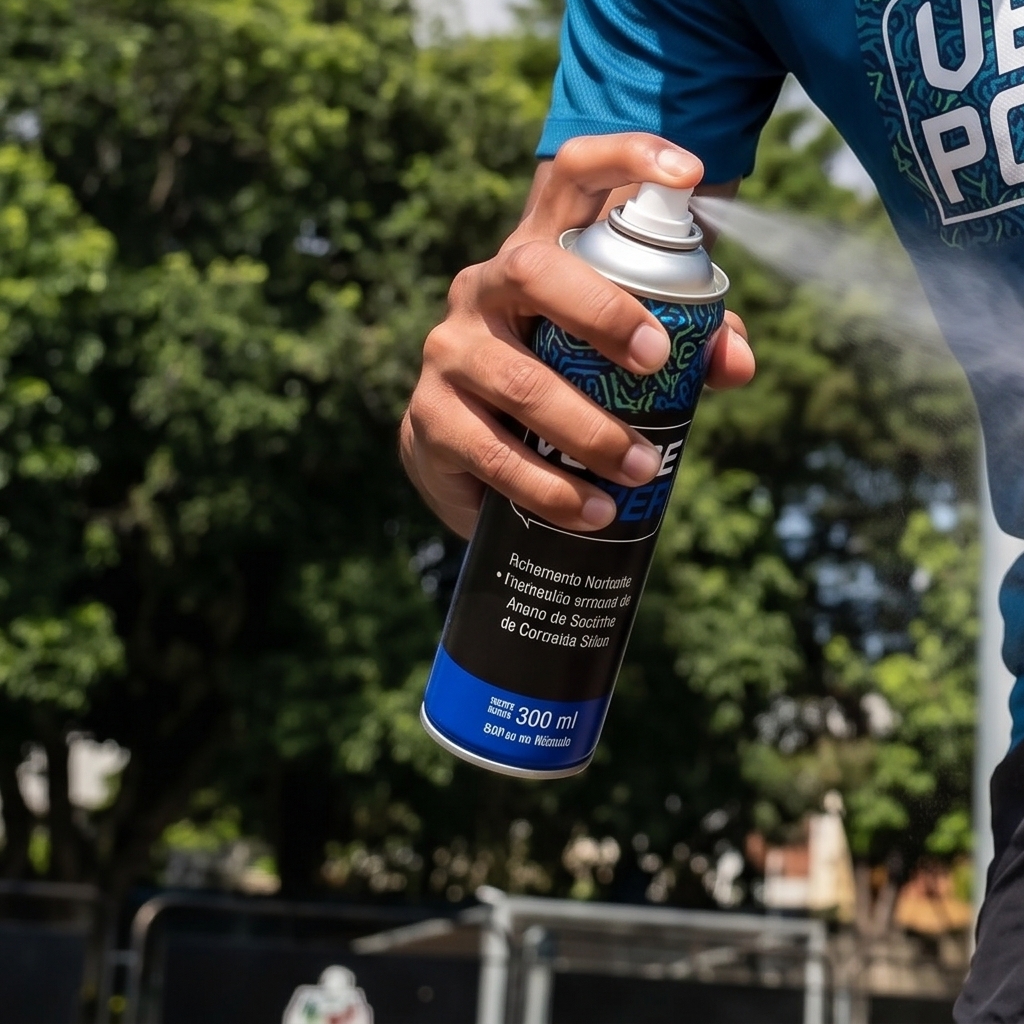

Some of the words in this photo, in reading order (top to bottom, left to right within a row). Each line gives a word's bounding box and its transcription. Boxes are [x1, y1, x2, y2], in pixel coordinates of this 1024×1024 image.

[500, 616, 516, 633] de
[550, 611, 567, 626] de
[515, 707, 553, 729] 300
[555, 711, 579, 730] ml
